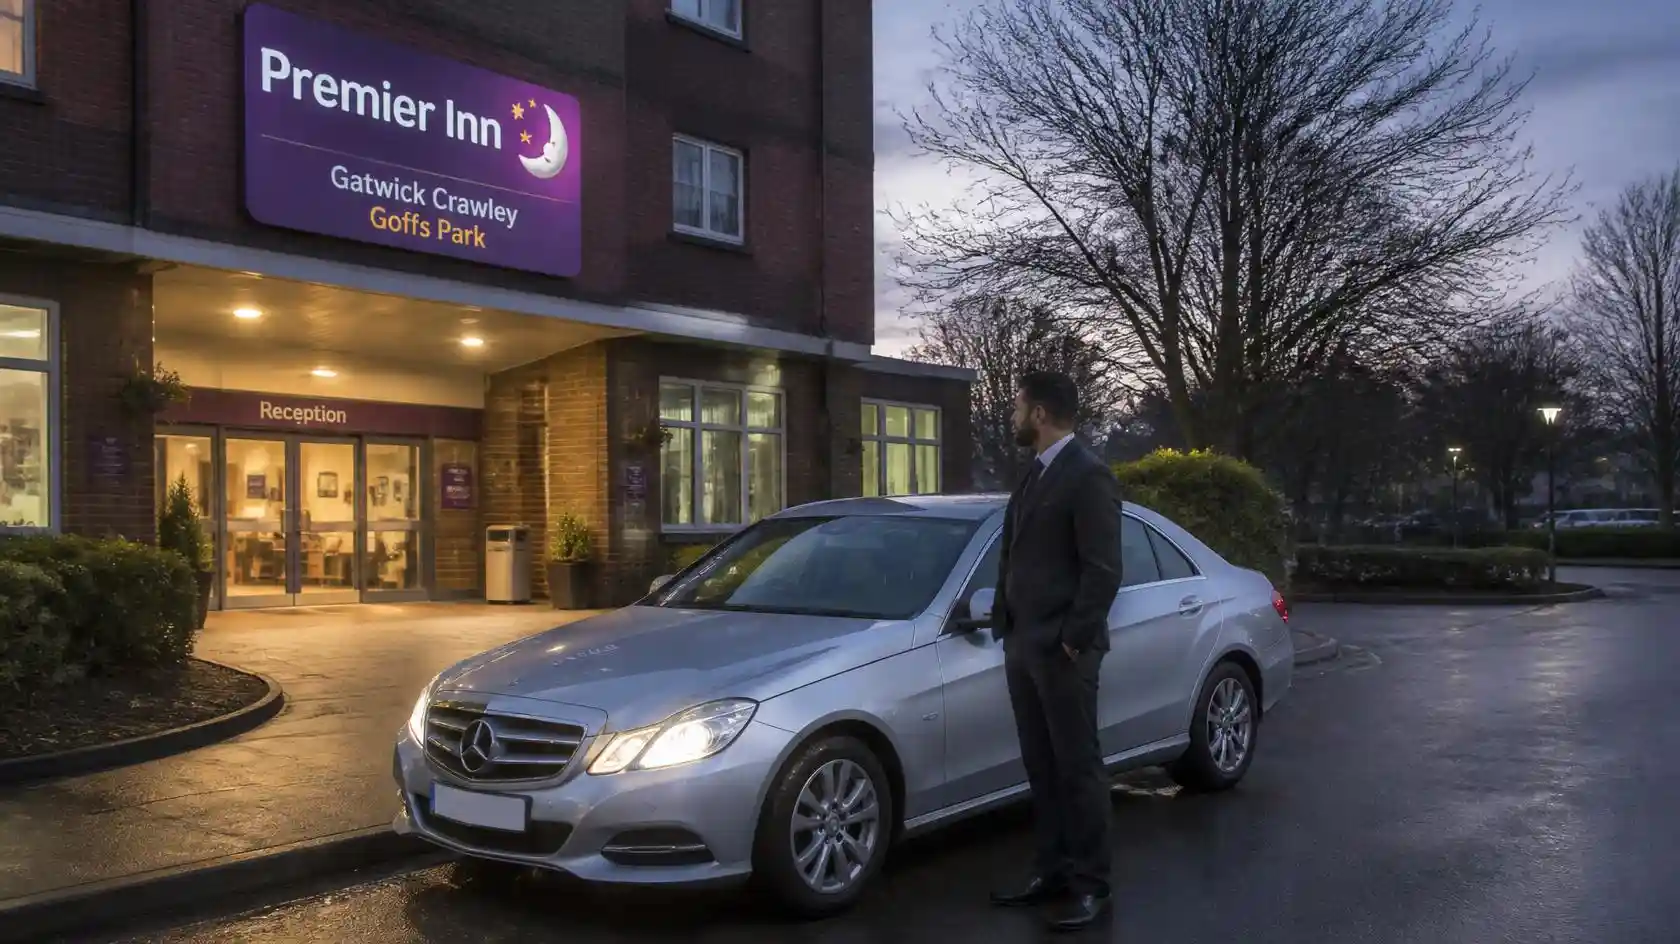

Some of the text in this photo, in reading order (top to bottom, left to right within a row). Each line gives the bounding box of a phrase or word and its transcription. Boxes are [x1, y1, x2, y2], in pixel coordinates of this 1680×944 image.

[261, 47, 502, 150] Premier Inn
[330, 165, 518, 229] Gatwick Crawley
[370, 206, 486, 248] Goffs Park
[260, 401, 346, 424] Reception
